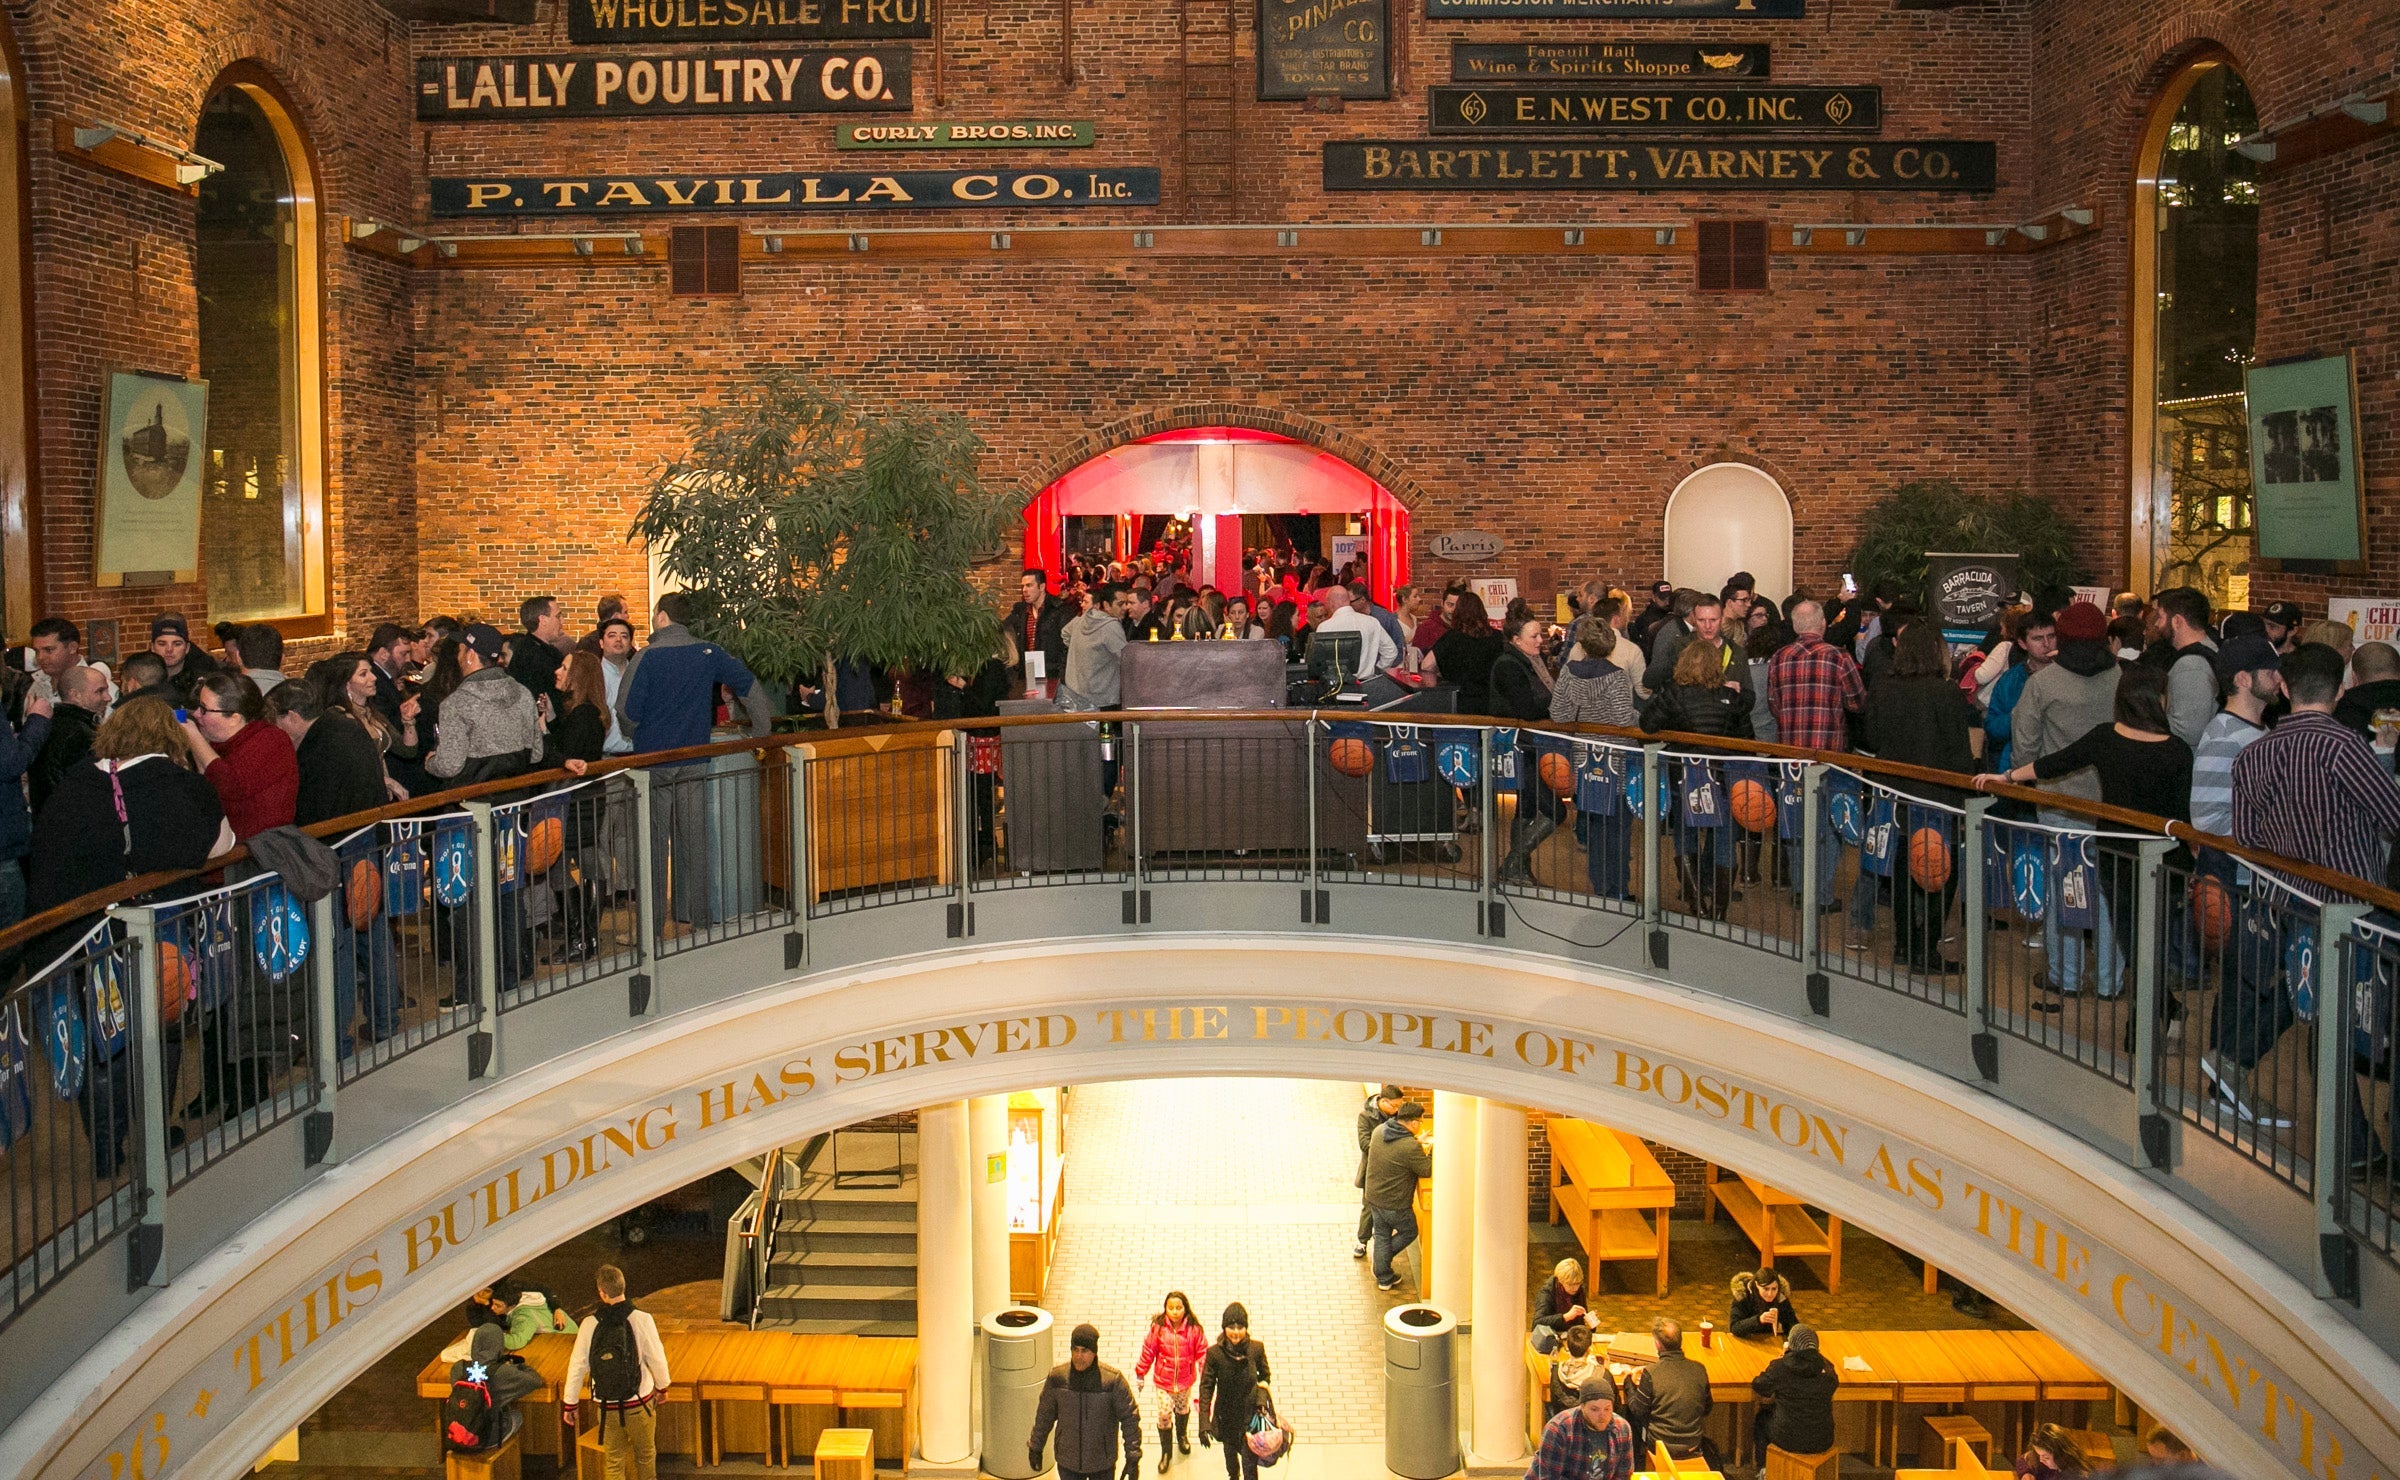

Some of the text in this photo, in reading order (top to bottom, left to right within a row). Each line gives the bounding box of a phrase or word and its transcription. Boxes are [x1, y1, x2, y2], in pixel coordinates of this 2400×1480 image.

[1343, 20, 1379, 43] CO.
[1527, 45, 1635, 58] Faneuil Hall
[1468, 58, 1691, 75] Wine & Spirits Shoppe
[595, 58, 803, 106] POULTRY
[821, 56, 894, 102] CO.
[1465, 99, 1480, 119] 65
[1830, 100, 1846, 120] 67
[852, 126, 939, 141] CURLY
[1362, 147, 1638, 181] BARTLETT,
[1646, 147, 1833, 180] VARNEY
[1847, 148, 1881, 180] &
[543, 177, 914, 207] TAVILLA
[952, 174, 1073, 201] CO.
[1088, 174, 1132, 198] Inc.
[1440, 537, 1496, 552] Parris
[1942, 571, 1993, 593] BARRACUDA
[1956, 600, 1988, 614] TAVERN
[2364, 624, 2394, 640] CUP
[290, 911, 301, 923] UP
[233, 1249, 383, 1395] THIS
[402, 1103, 680, 1276] BUILDING
[696, 1056, 816, 1131] HAS
[834, 1013, 1078, 1086] SERVED
[1097, 1005, 1228, 1043] THE
[1249, 1005, 1494, 1058] PEOPLE
[1514, 1030, 1596, 1075] OF
[1612, 1050, 1849, 1167] BOSTON
[1862, 1142, 1945, 1211] AS
[1963, 1182, 2090, 1298] THE
